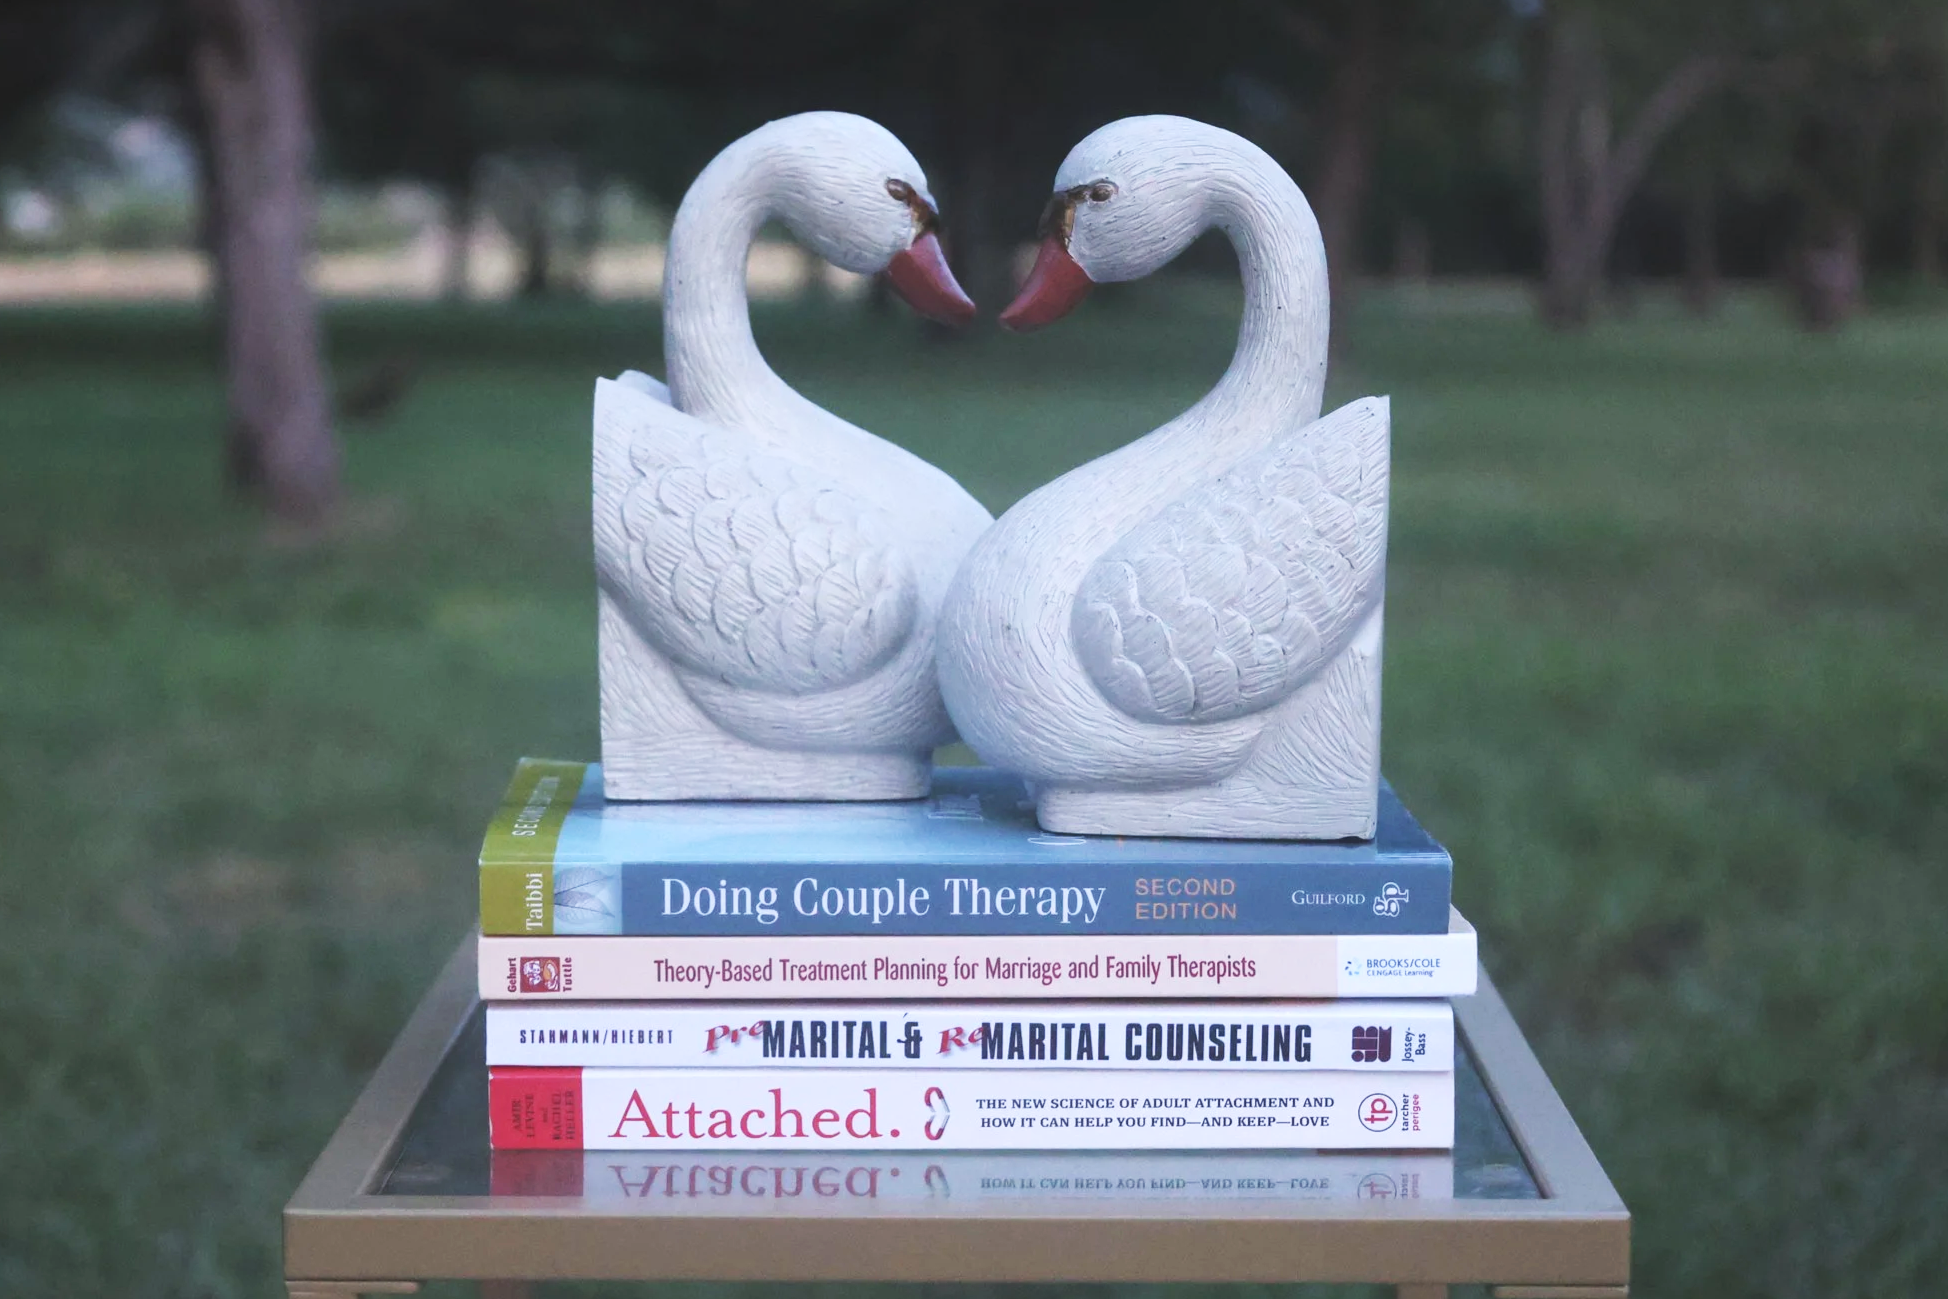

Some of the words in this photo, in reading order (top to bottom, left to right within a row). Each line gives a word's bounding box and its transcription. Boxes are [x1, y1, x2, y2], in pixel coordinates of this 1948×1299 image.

[526, 873, 543, 931] Taibbi
[662, 878, 779, 924] Doing
[793, 878, 930, 924] Couple
[944, 878, 1106, 924] Therapy
[1135, 878, 1236, 896] SECOND
[1292, 890, 1365, 905] GUILFORD
[1135, 902, 1237, 919] EDITION
[507, 957, 517, 992] Gehart
[563, 957, 572, 992] Tuttle
[654, 958, 772, 988] Theory-Based
[779, 959, 867, 982] Treatment
[874, 957, 947, 987] Planning
[954, 956, 979, 980] for
[985, 956, 1062, 985] Marriage
[1068, 955, 1098, 979] and
[1106, 955, 1161, 984] Family
[1167, 954, 1256, 984] Therapists
[1367, 959, 1441, 968] BROOKS/COLE
[520, 1029, 673, 1044] STAHMANN/HIEBERT
[897, 1013, 923, 1059] &
[1125, 1023, 1312, 1063] COUNSELING
[1402, 1027, 1415, 1062] Jossey-
[1415, 1033, 1426, 1055] Bass
[607, 1087, 900, 1139] Attached.
[976, 1099, 1007, 1109] THE
[1012, 1099, 1046, 1109] NEW
[1051, 1098, 1114, 1109] SCIENCE
[1120, 1098, 1138, 1109] OF
[1142, 1098, 1191, 1109] ADULT
[1195, 1098, 1299, 1109] ATTACHMENT
[1303, 1097, 1334, 1108] AND
[1364, 1098, 1393, 1124] tp
[1402, 1093, 1410, 1131] tarcher
[1412, 1094, 1421, 1131] perigee
[981, 1117, 1015, 1128] HOW
[1021, 1117, 1035, 1128] IT
[1040, 1117, 1069, 1128] CAN
[1074, 1117, 1112, 1128] HELP
[1118, 1117, 1146, 1128] YOU
